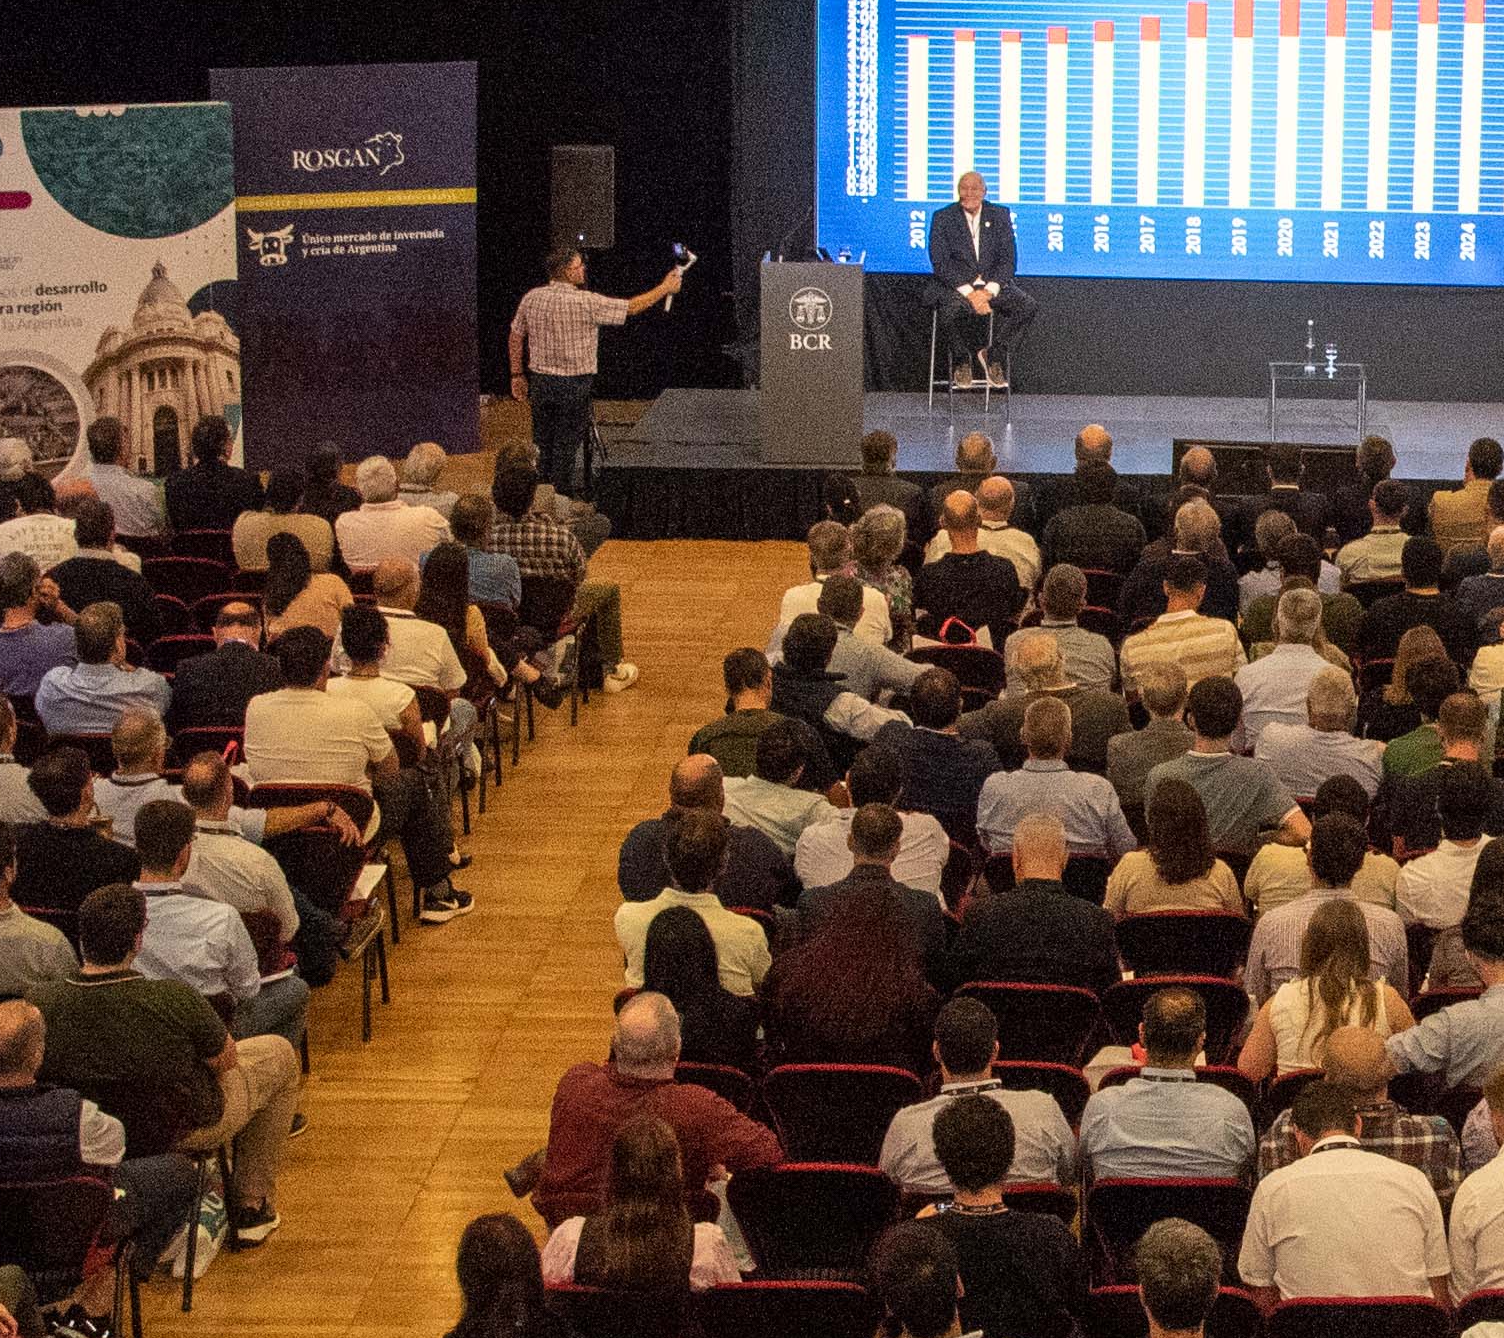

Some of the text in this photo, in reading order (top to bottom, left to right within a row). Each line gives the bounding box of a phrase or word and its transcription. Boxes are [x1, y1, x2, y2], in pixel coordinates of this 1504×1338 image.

[292, 148, 381, 171] ROSGAN
[302, 232, 331, 245] Único
[334, 231, 378, 243] mercado
[379, 231, 392, 241] de
[910, 210, 926, 249] 2012
[1048, 213, 1064, 252] 2015
[1094, 213, 1110, 253] 2016
[1140, 215, 1155, 254] 2017
[1185, 216, 1201, 255] 2018
[1231, 217, 1247, 256] 2019
[1277, 218, 1293, 257] 2020
[1323, 221, 1339, 258] 2021
[1369, 220, 1385, 259] 2022
[1414, 221, 1430, 260] 2023
[1460, 222, 1476, 261] 2024
[302, 247, 308, 258] y
[334, 245, 346, 255] de
[348, 243, 397, 255] Argentina
[17, 300, 63, 316] región
[35, 281, 108, 297] desarrollo
[790, 334, 832, 350] BCR
